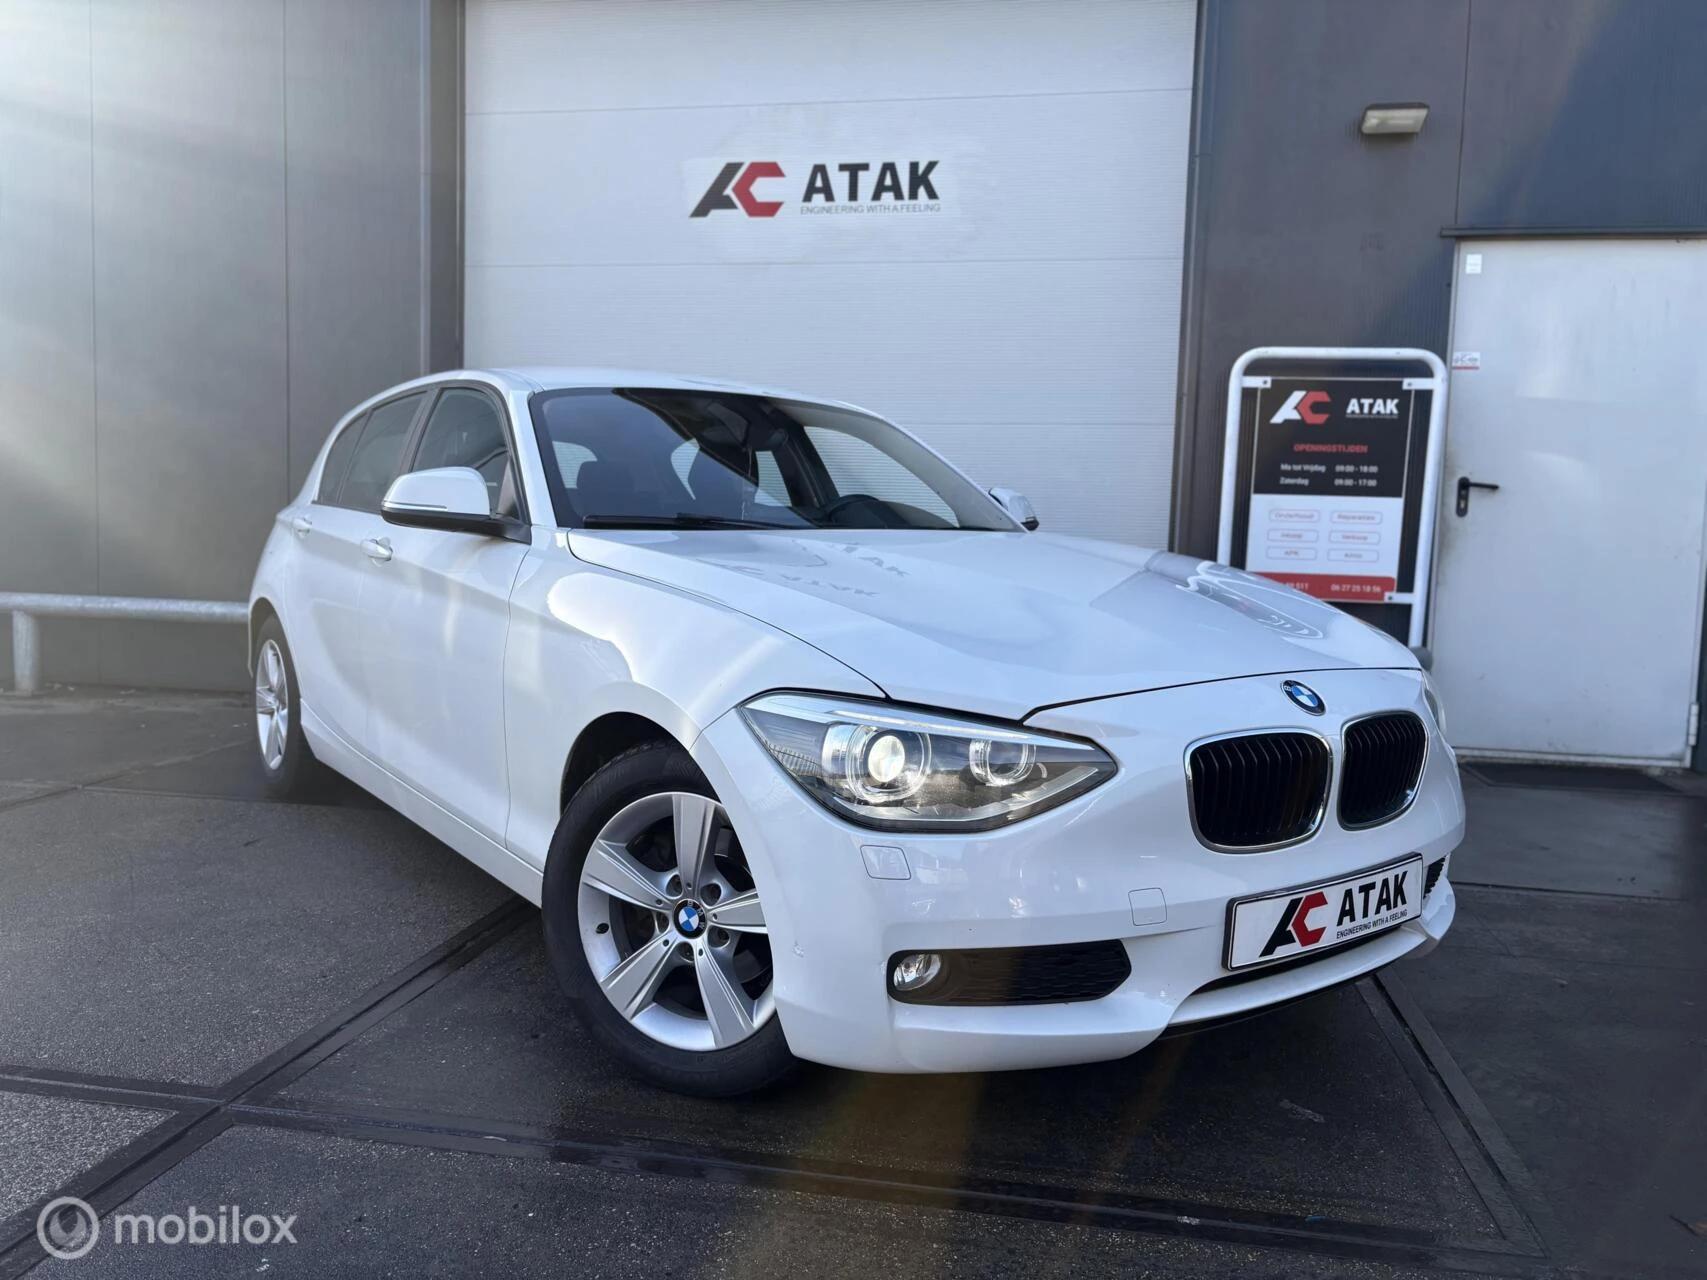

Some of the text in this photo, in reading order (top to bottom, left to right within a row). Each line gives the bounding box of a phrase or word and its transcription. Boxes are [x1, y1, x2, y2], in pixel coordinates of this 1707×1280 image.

[802, 160, 940, 203] ATAK
[800, 203, 941, 216] ENGINEERING WITH A FEELING
[1346, 398, 1399, 414] ATAK
[1293, 443, 1368, 453] OPENINGSTIJDEN
[1280, 477, 1309, 486] Zaterdag
[1336, 870, 1408, 926] ATAK
[1336, 921, 1371, 939] ENGINEERING
[1372, 918, 1384, 928] WITH
[1389, 909, 1408, 922] FEELING
